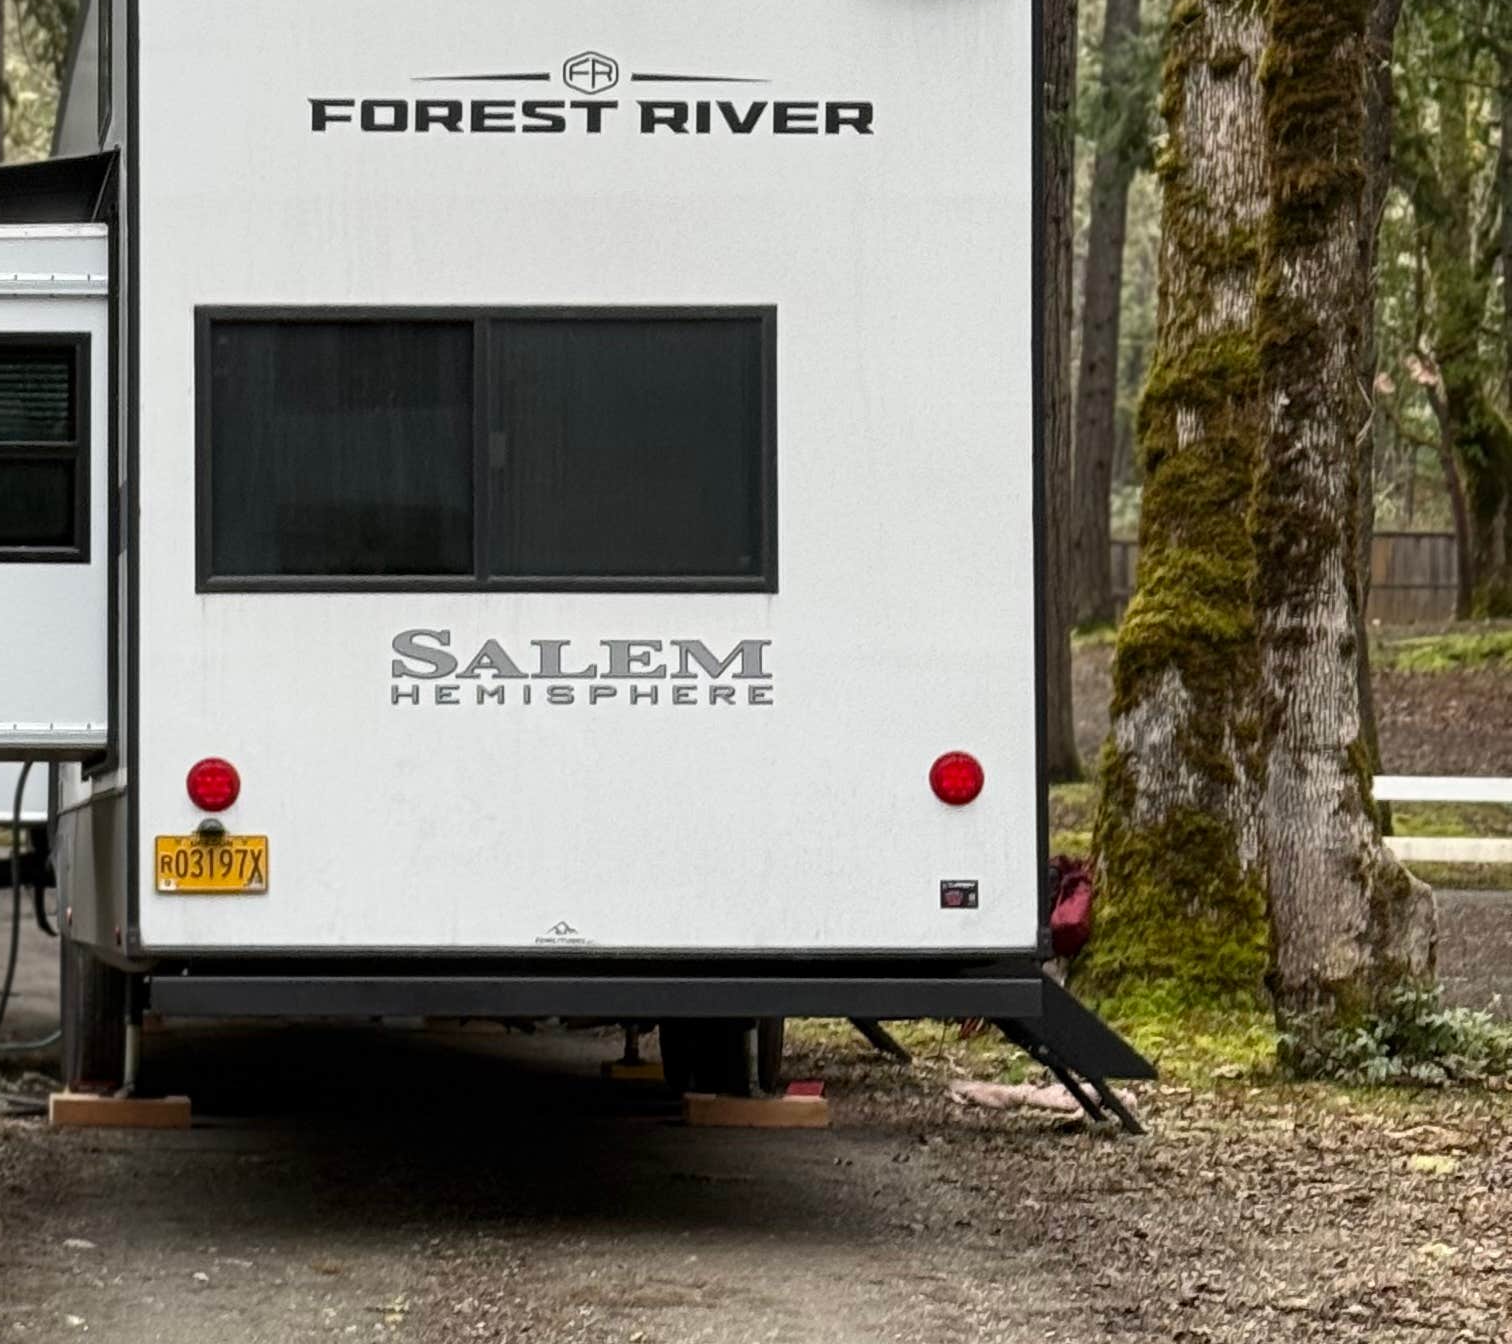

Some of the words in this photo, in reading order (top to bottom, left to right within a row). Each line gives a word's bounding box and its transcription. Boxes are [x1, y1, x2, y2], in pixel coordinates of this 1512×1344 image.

[567, 56, 614, 91] FR
[308, 98, 618, 134] FOREST
[636, 99, 874, 135] RIVER
[391, 629, 773, 679] SALEM
[390, 684, 773, 705] HEMISPHERE
